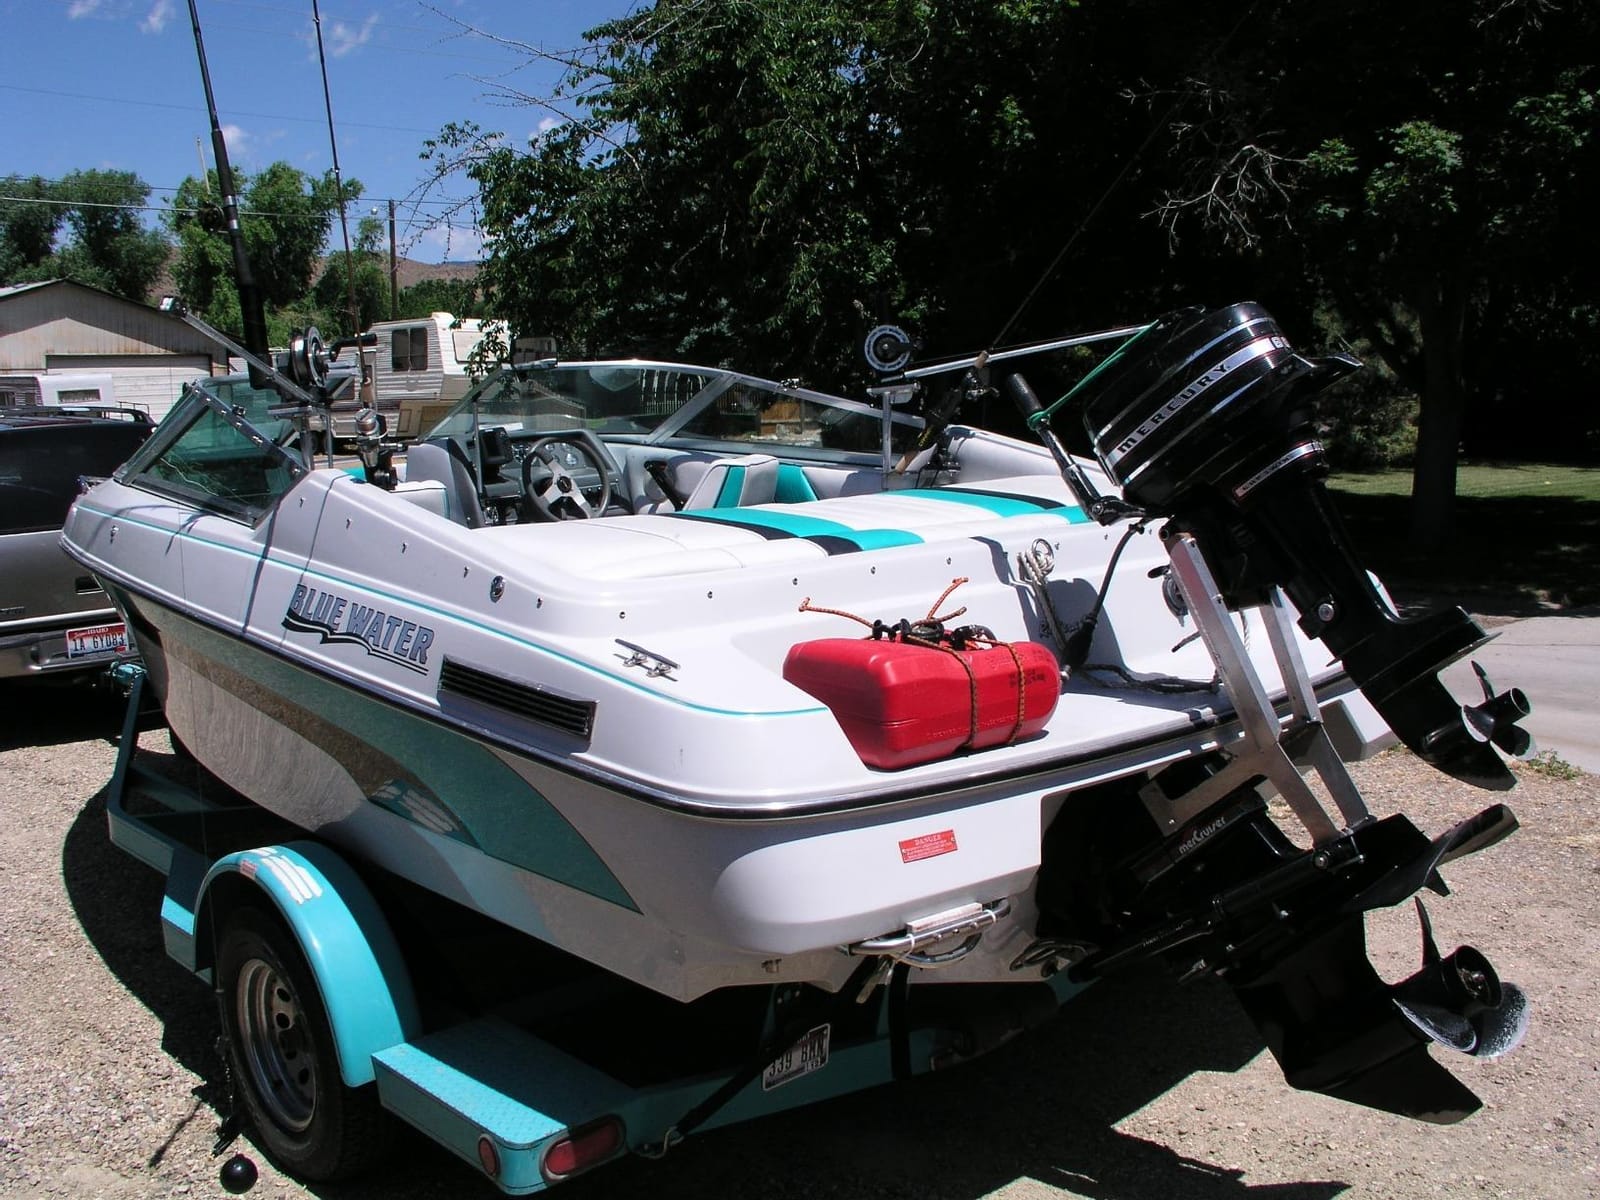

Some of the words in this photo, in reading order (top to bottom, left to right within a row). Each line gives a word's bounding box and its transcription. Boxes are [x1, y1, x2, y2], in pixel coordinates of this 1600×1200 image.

[1117, 363, 1228, 454] MERCURY
[288, 584, 347, 631] BLUE
[346, 602, 435, 665] WATER
